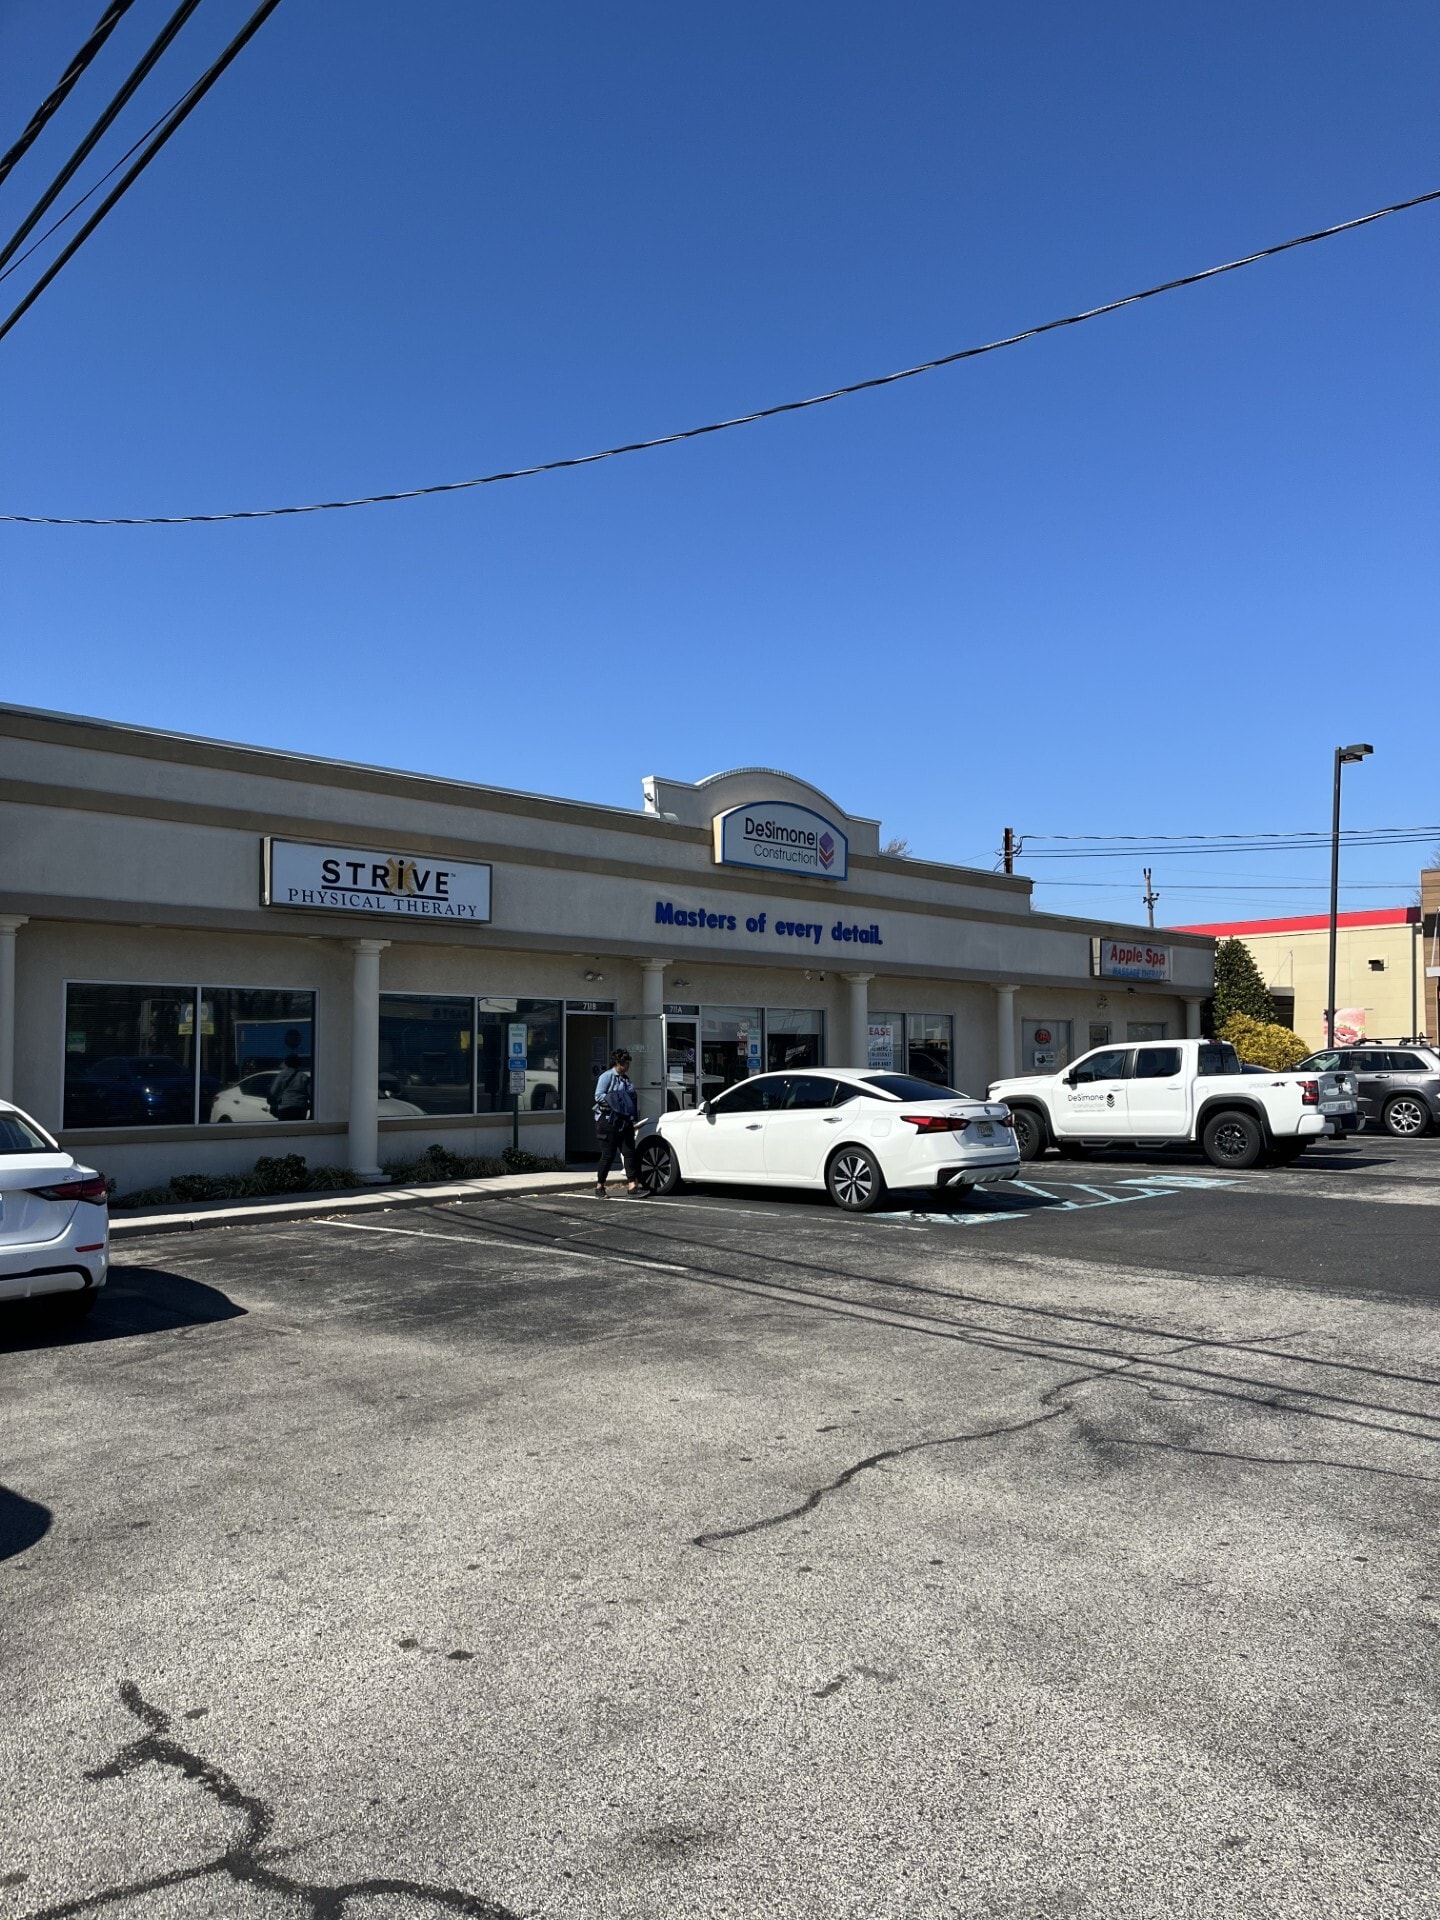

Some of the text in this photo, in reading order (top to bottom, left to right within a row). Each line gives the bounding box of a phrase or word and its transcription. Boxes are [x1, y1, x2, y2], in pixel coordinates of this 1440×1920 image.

[745, 817, 816, 846] DeSimone
[753, 844, 816, 865] Construction
[288, 888, 478, 917] PHYSICAL THERAPY
[655, 902, 883, 945] Masters of every detail.
[1110, 944, 1166, 968] Apple Spa
[582, 1002, 597, 1010] 711B
[669, 1005, 683, 1014] 711A
[869, 1027, 891, 1036] EASE
[1067, 1093, 1104, 1102] DeSimone
